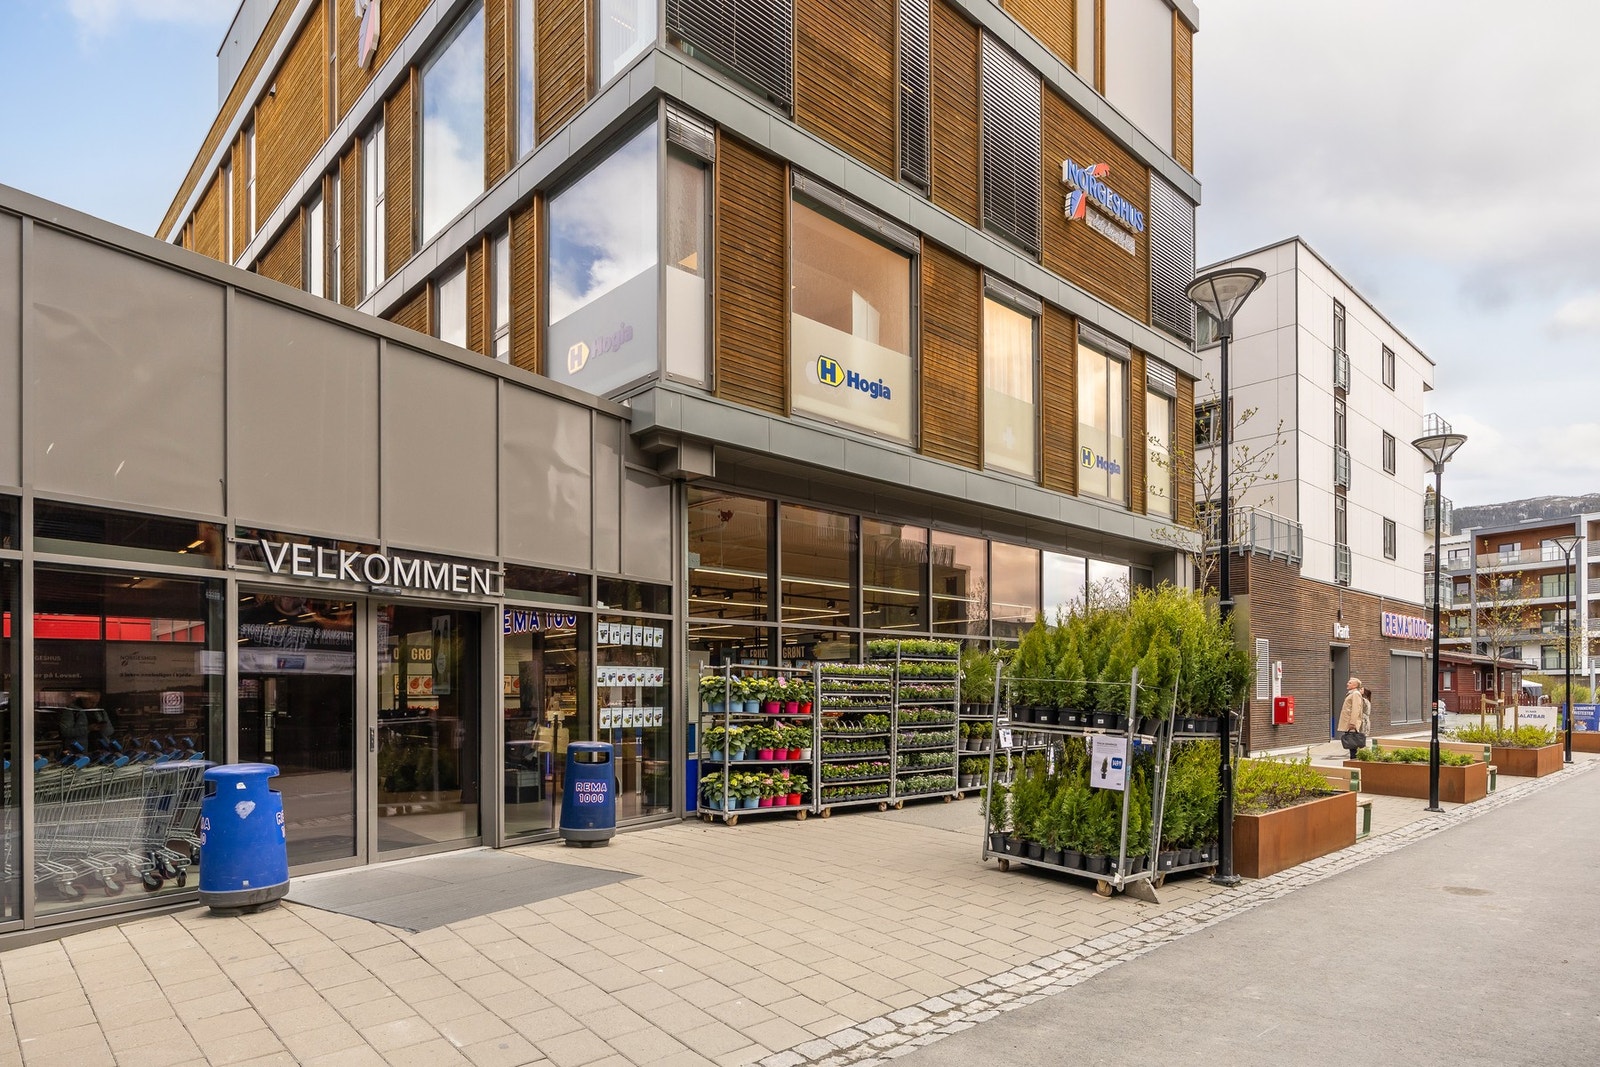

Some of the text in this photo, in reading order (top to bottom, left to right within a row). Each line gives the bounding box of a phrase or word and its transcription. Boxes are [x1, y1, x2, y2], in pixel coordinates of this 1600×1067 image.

[1063, 158, 1144, 233] NORGESHUS
[591, 321, 634, 360] Hogia
[846, 369, 891, 401] Hogia
[1096, 455, 1121, 475] Hogia
[260, 538, 490, 595] VELKOMMEN
[503, 608, 577, 635] EMA 100
[1384, 613, 1409, 636] REMA
[1410, 617, 1428, 639] 1000
[411, 647, 432, 661] GRØ
[782, 646, 805, 659] GRØNT
[575, 782, 607, 793] REMA
[579, 793, 604, 803] 1000
